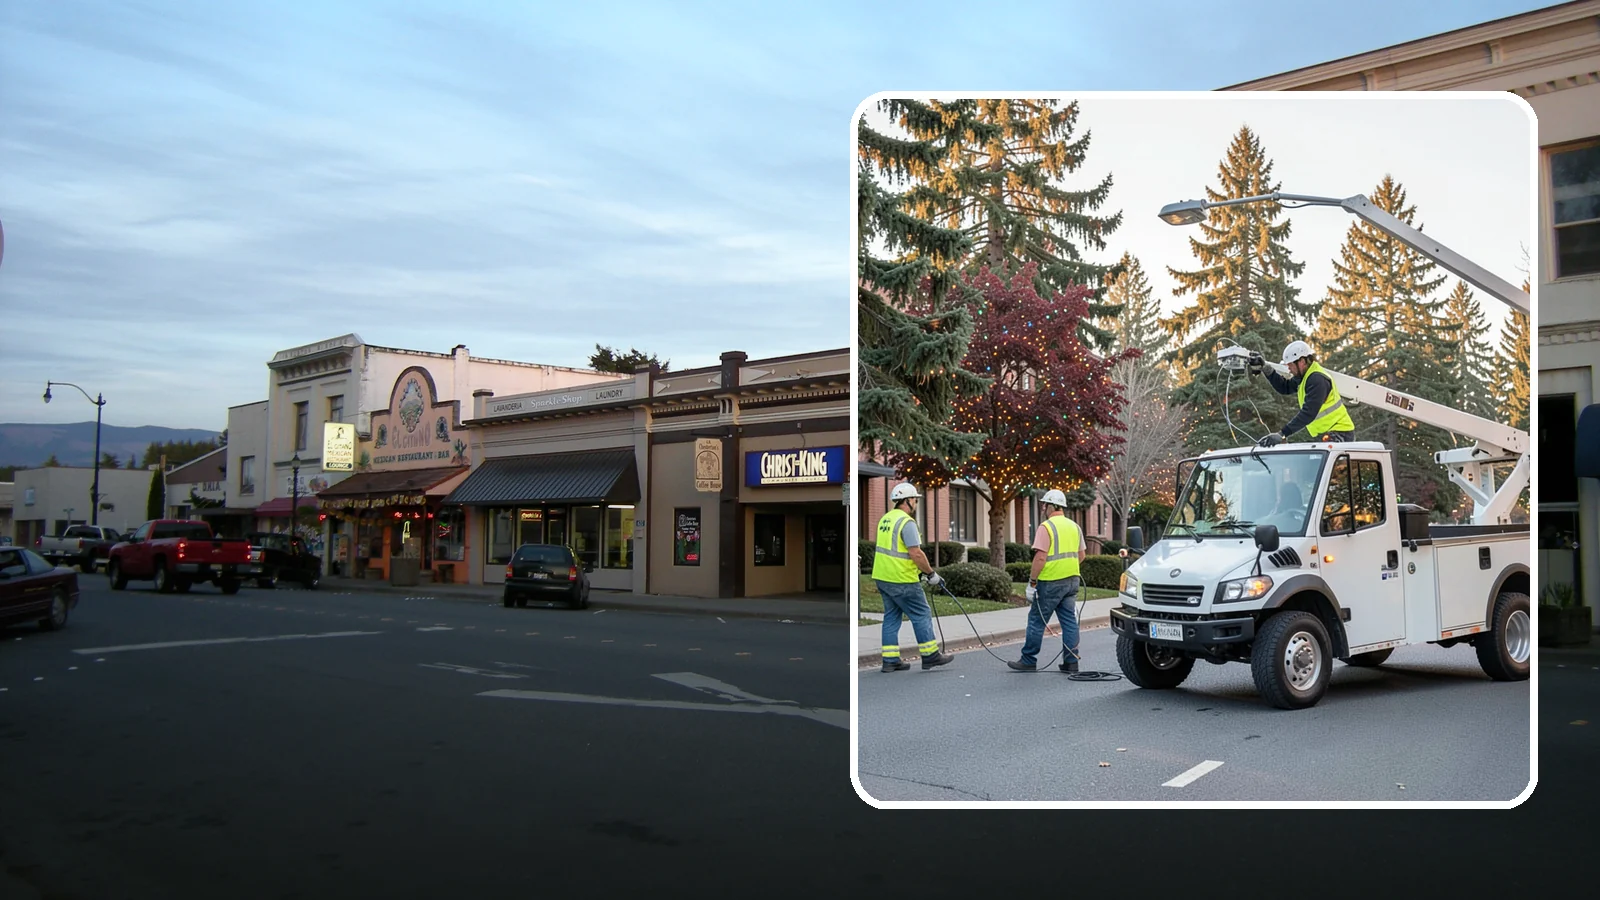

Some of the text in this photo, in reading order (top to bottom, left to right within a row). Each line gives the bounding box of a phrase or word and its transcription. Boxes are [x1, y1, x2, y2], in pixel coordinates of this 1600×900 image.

[595, 389, 623, 399] LAUNDRY
[493, 402, 522, 412] LAVANDERIA
[530, 394, 582, 408] Sparkle Shop
[373, 450, 450, 464] MEXICAN RESTAURANT BAR
[761, 450, 827, 477] CHRIST KING
[697, 480, 722, 488] Coffee House
